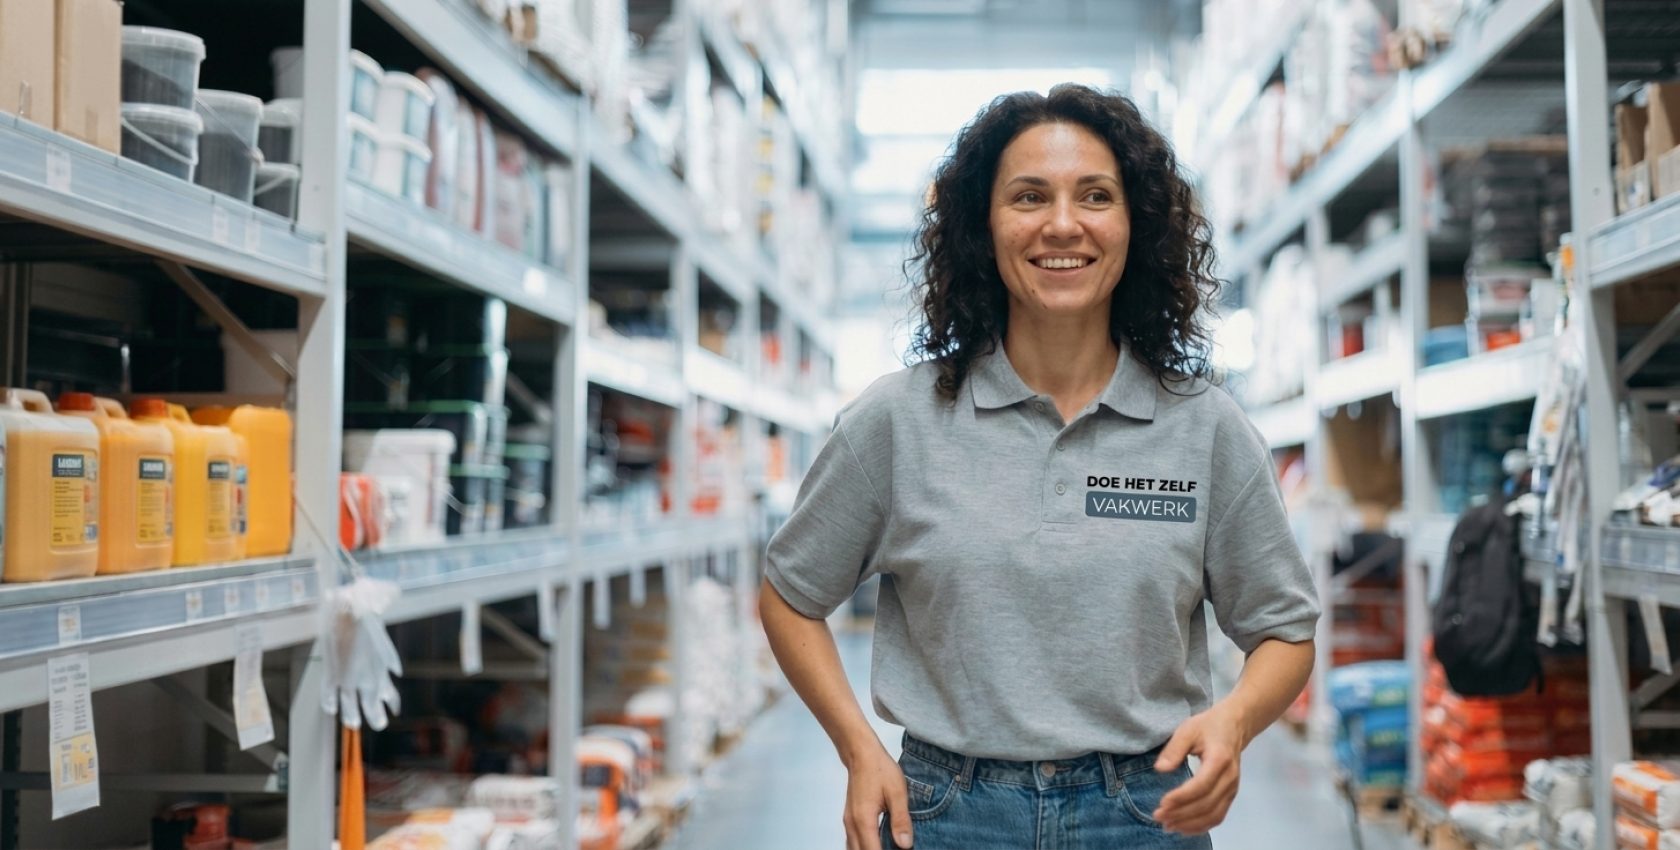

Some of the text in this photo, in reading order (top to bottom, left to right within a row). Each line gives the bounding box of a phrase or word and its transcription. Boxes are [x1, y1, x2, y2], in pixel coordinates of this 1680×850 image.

[1087, 476, 1197, 492] DOE HET ZELF
[1092, 497, 1190, 518] VAKWERK
